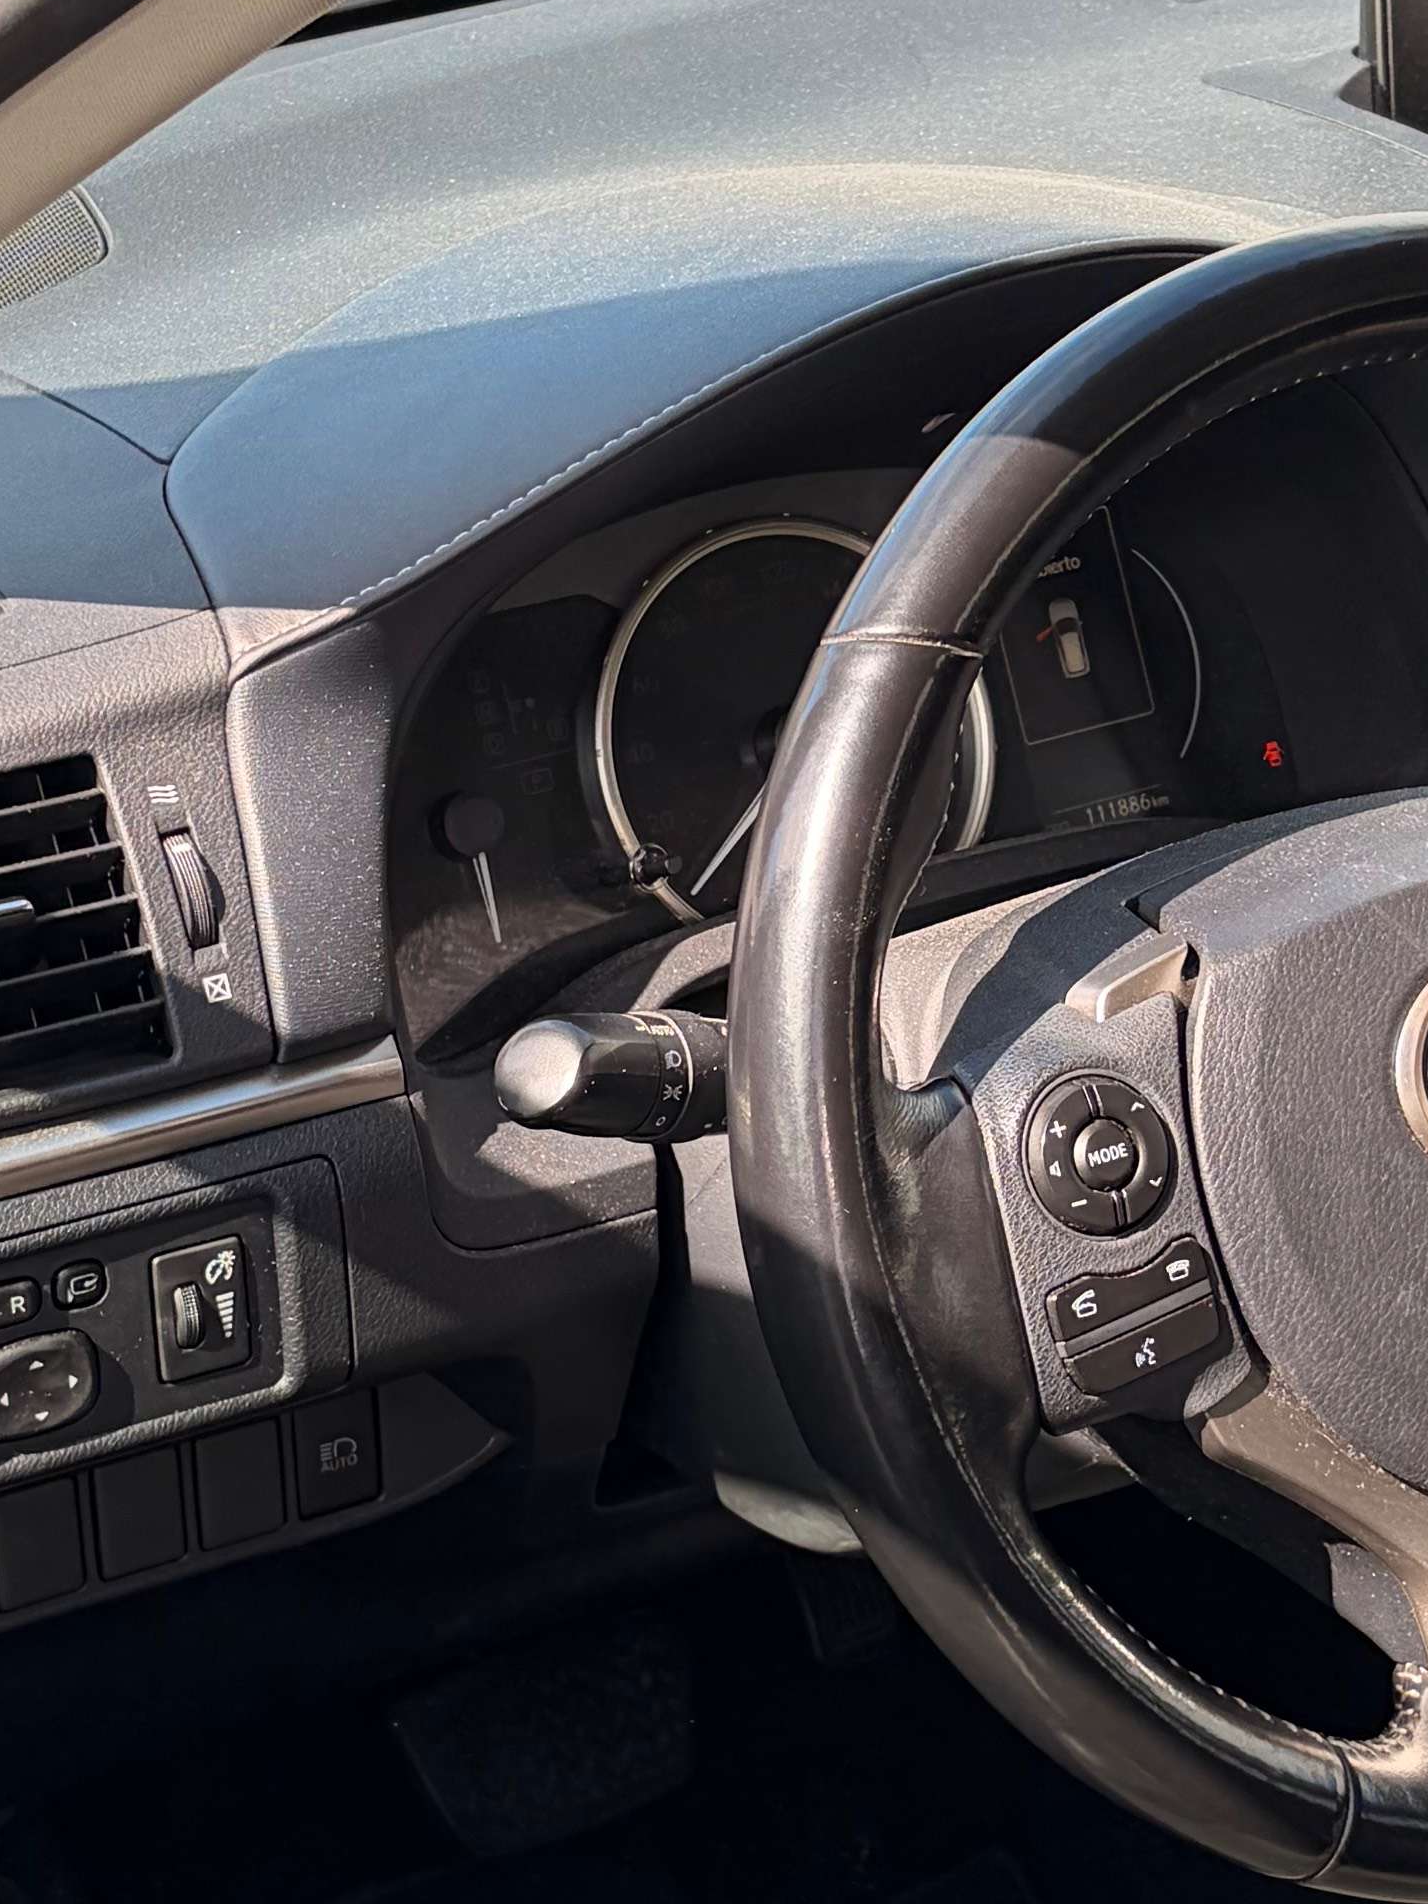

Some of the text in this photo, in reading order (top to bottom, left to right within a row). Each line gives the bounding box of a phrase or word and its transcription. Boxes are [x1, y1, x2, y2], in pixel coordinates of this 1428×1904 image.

[1086, 793, 1151, 825] 111886
[1087, 1140, 1129, 1168] MODE
[10, 1295, 27, 1314] R
[320, 1455, 358, 1473] AUTO
